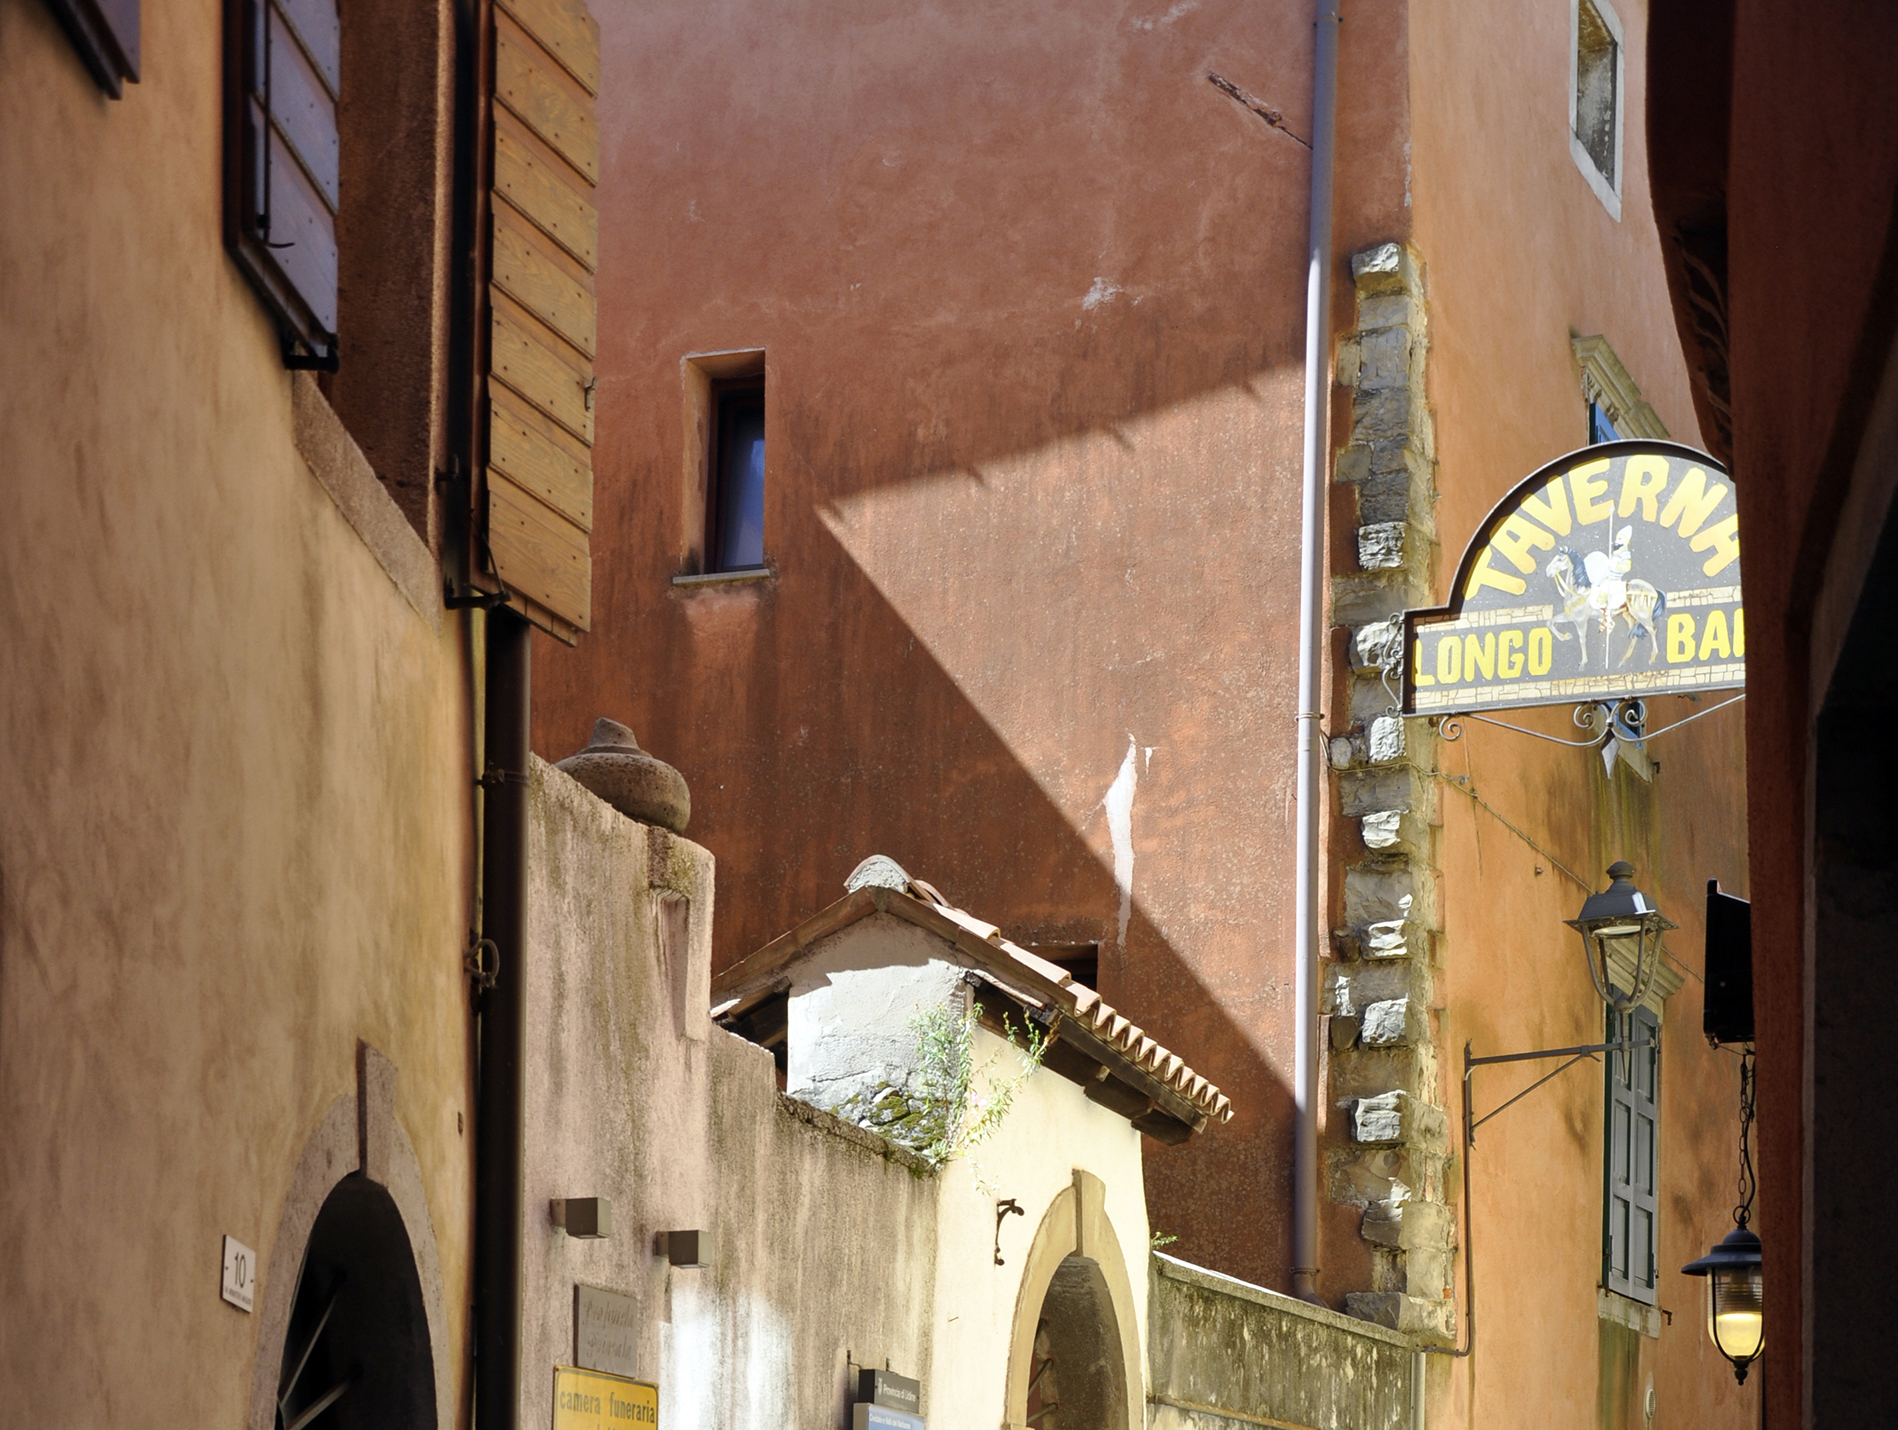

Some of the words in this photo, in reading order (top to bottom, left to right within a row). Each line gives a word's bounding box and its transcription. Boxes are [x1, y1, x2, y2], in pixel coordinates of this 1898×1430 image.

[1462, 454, 1741, 600] TAVERNA
[1413, 627, 1553, 687] LONGO
[234, 1251, 246, 1289] 10
[560, 1391, 601, 1415] camera
[609, 1391, 655, 1424] funeraria
